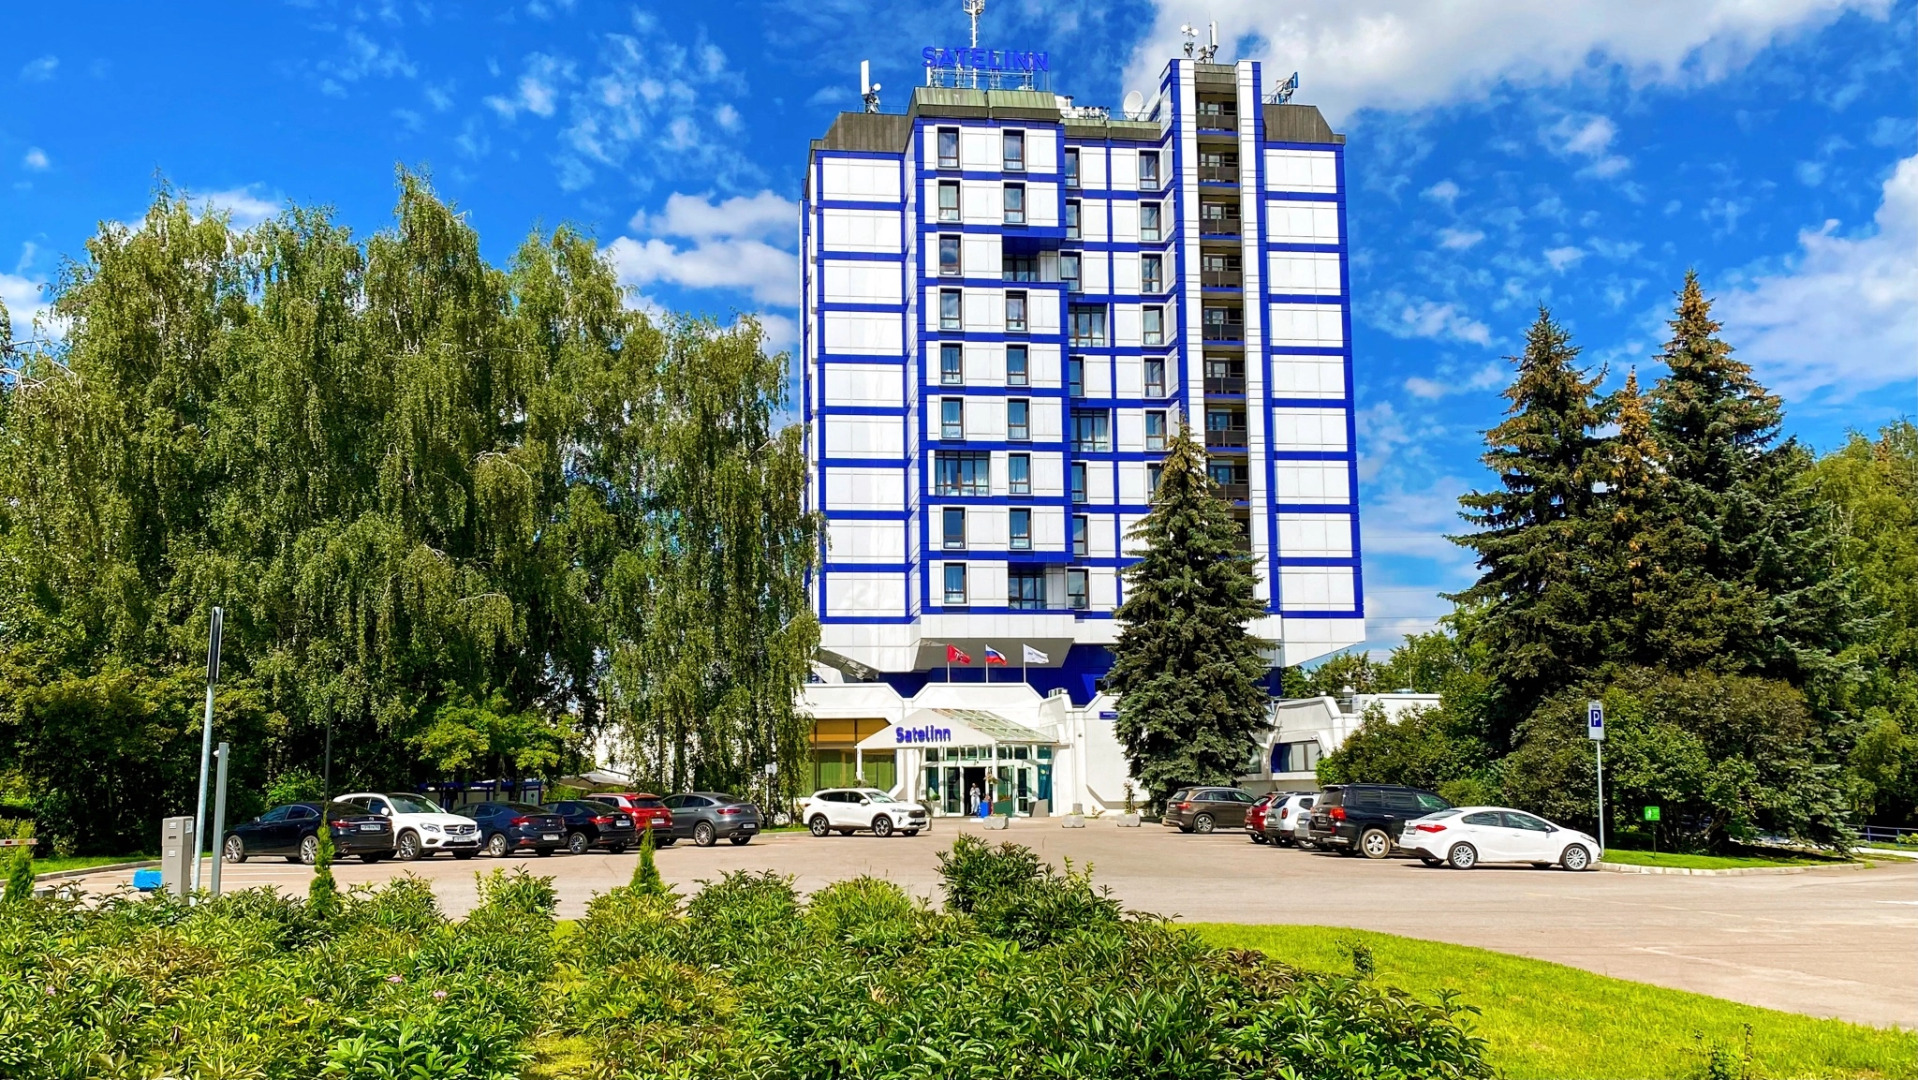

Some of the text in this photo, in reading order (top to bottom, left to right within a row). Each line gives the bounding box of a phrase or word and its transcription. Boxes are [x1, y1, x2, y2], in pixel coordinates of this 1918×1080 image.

[921, 46, 1049, 72] SATELINN
[1593, 710, 1600, 726] P
[896, 725, 951, 743] Satelinn
